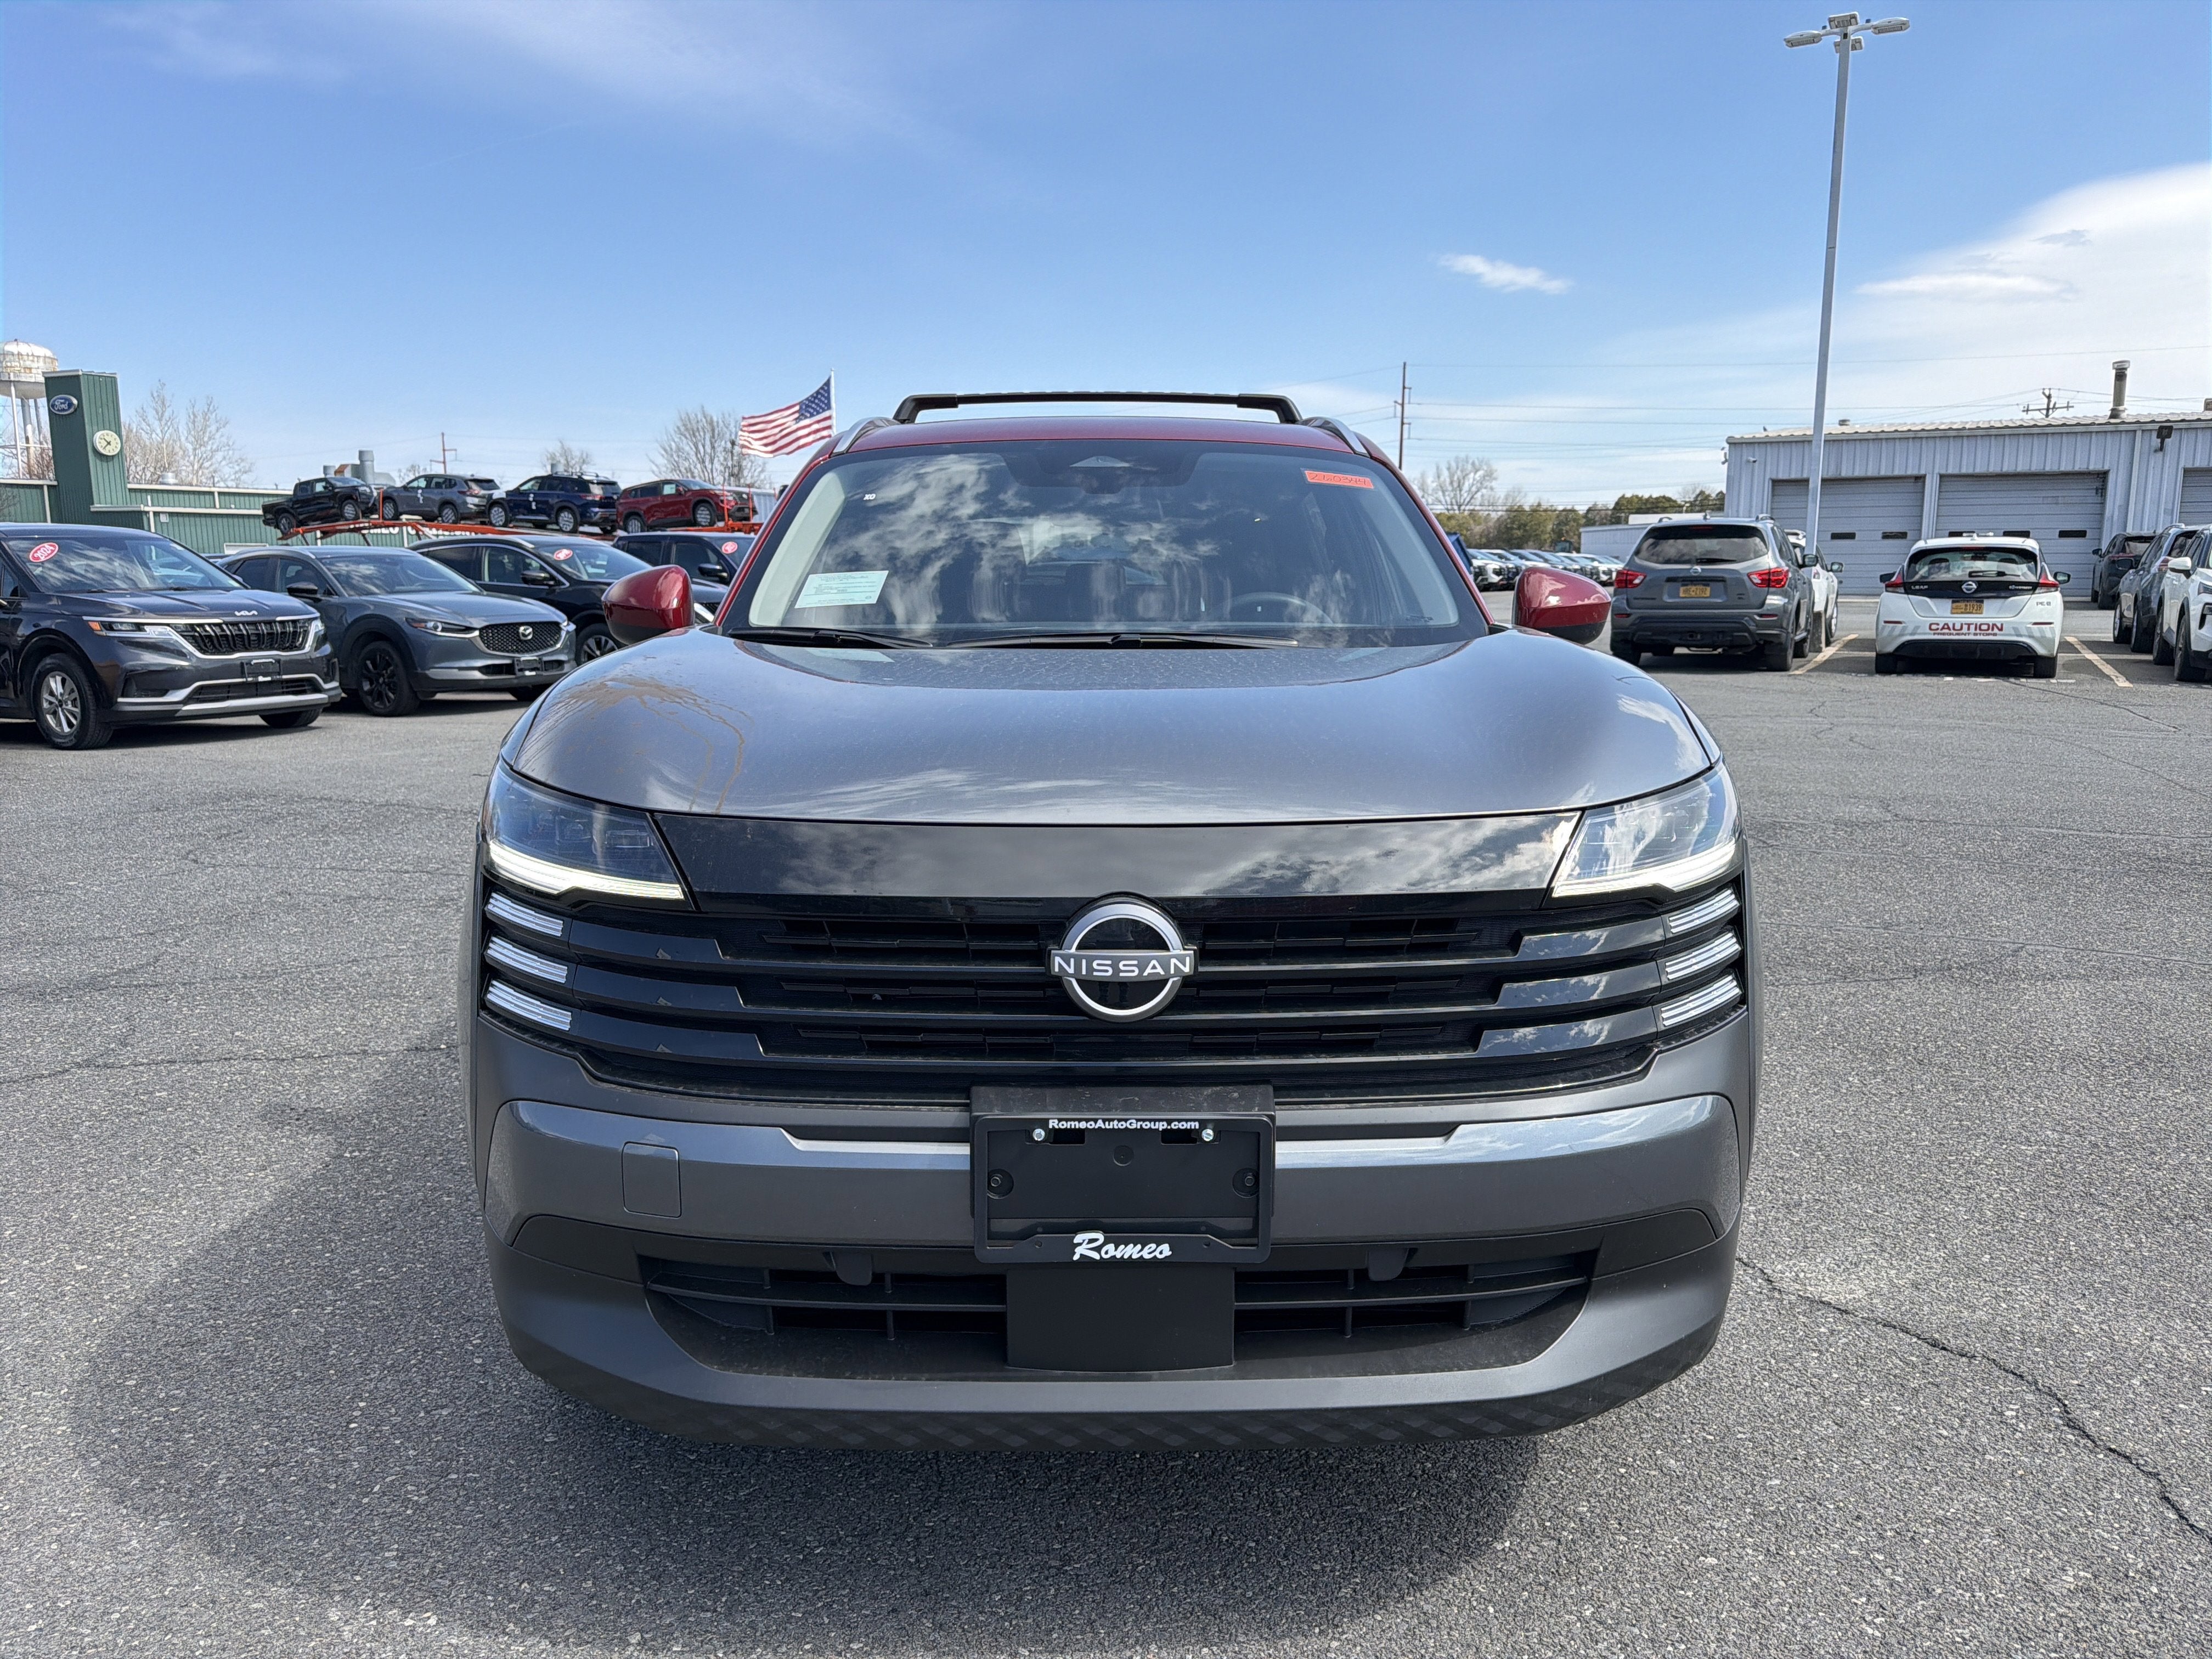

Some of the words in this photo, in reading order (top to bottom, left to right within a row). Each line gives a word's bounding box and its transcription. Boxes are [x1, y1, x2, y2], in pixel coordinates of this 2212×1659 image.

[54, 399, 69, 410] Ford
[1309, 473, 1366, 486] 260344
[1928, 623, 2004, 631] CAUTION
[1054, 956, 1190, 977] NISSAN
[1048, 1119, 1199, 1131] RomeoAutoGroup.com
[1073, 1232, 1172, 1261] Romeo
